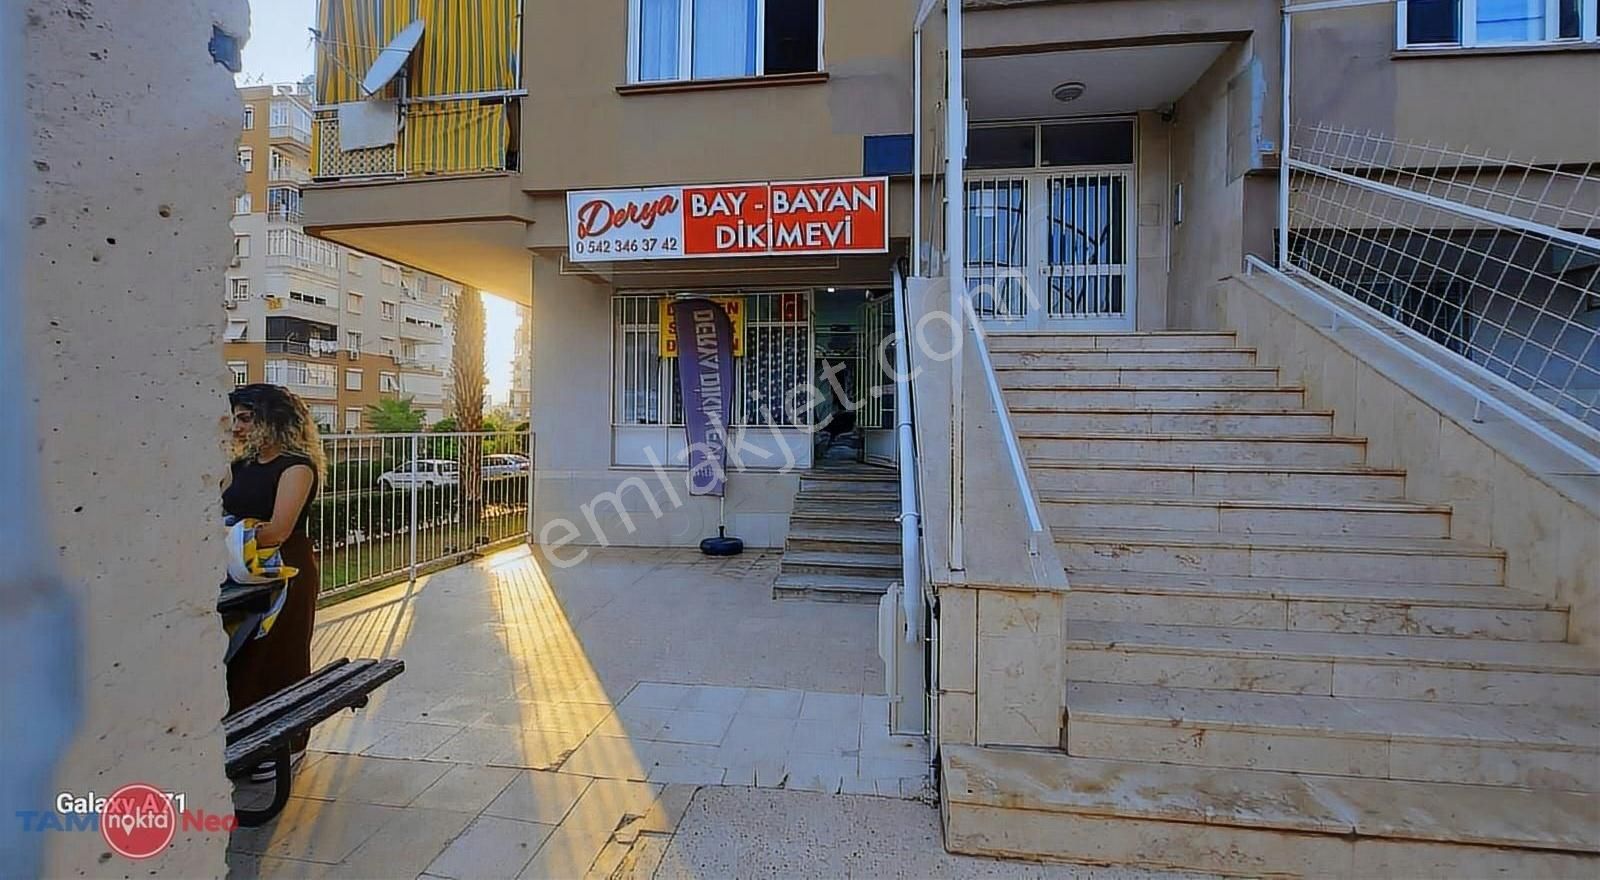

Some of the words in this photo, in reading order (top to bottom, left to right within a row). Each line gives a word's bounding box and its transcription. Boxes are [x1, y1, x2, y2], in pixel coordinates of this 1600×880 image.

[577, 193, 679, 239] Derya
[691, 191, 747, 217] BAY
[772, 186, 877, 214] BAYAN
[576, 241, 584, 255] 0
[588, 240, 611, 254] 542
[615, 239, 638, 253] 346
[642, 238, 658, 252] 37
[662, 237, 678, 251] 42
[716, 214, 852, 250] DİKİMEVİ
